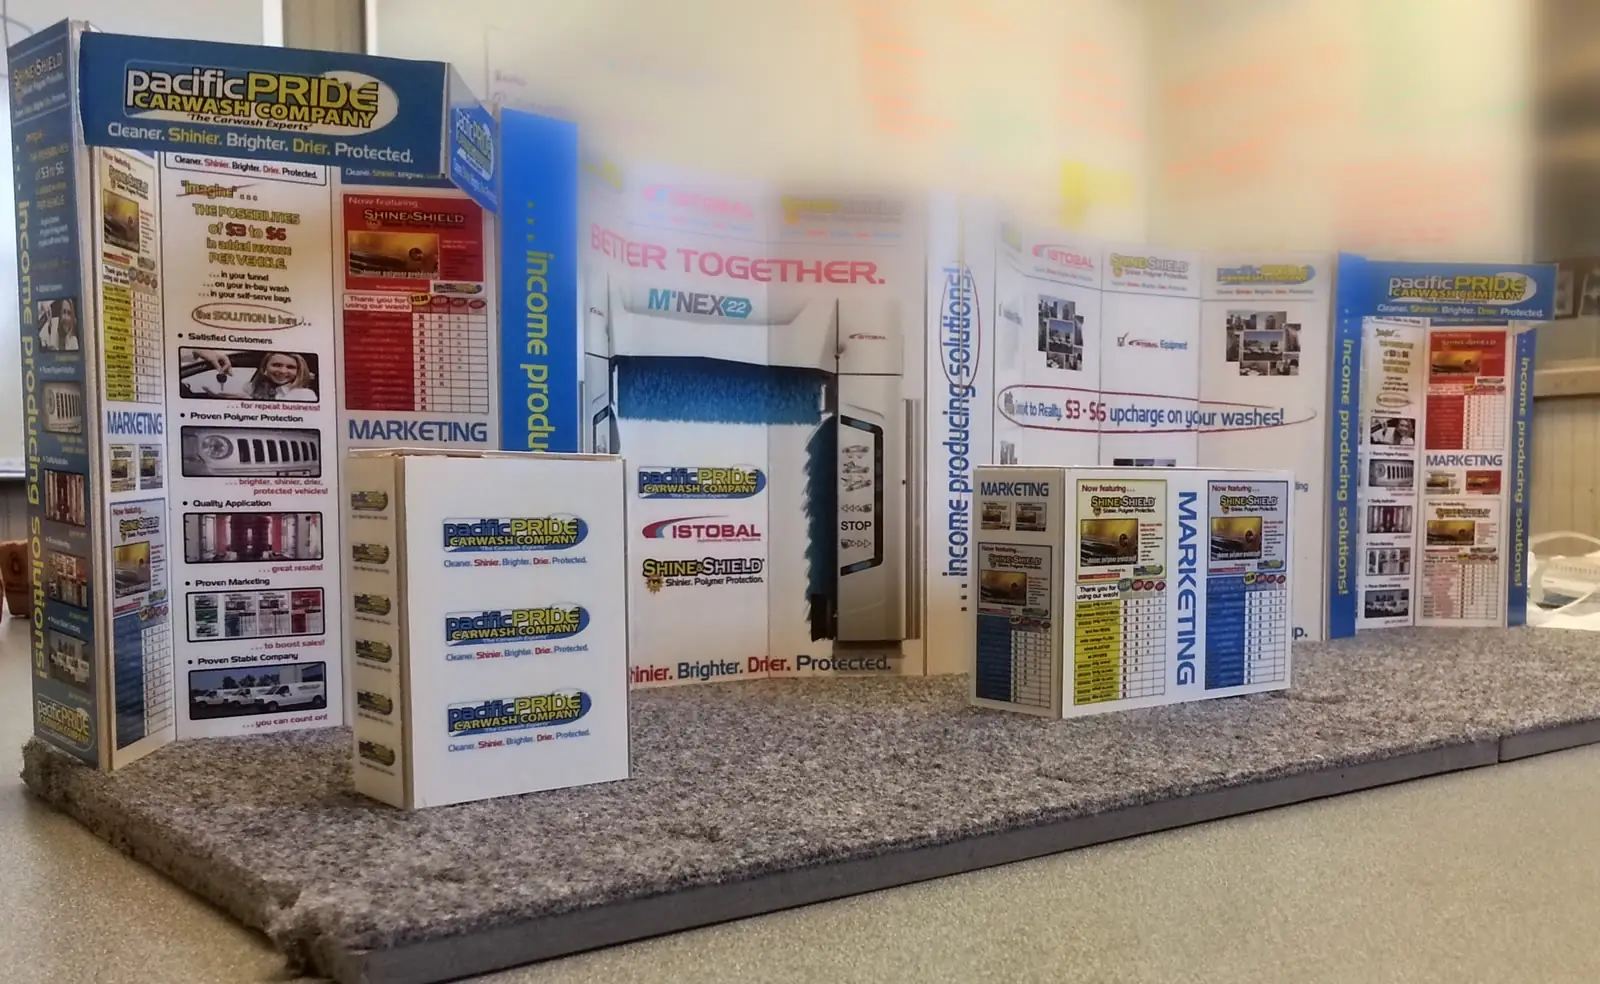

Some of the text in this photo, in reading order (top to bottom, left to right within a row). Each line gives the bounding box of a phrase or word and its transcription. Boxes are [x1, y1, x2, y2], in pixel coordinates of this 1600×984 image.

[134, 90, 379, 128] CARWASH COMPANY
[213, 115, 264, 127] Carwash
[107, 121, 414, 164] Cleaner. Shinier. Brighter. Drier. Protected.
[174, 155, 318, 179] Cleaner. Shinier. Brighter. Drier. Protected.
[192, 203, 217, 216] THE
[208, 221, 287, 242] of $3 to $6
[218, 239, 251, 252] added
[208, 251, 236, 266] PER
[590, 223, 886, 285] BETTER TOGETHER.
[229, 272, 245, 282] your
[247, 272, 269, 281] tunnel
[226, 281, 242, 290] your
[269, 284, 290, 293] wash
[218, 292, 235, 301] your
[350, 295, 375, 304] Thank
[377, 296, 394, 305] you
[345, 302, 368, 310] using
[726, 299, 748, 315] 22
[213, 310, 267, 325] SOLUTION
[188, 332, 273, 345] Satisfied Customers
[520, 249, 556, 453] income produ
[254, 402, 280, 412] repeat
[1065, 399, 1081, 420] $3
[1089, 400, 1107, 423] $6
[1110, 405, 1165, 427] upcharge
[1167, 409, 1183, 424] on
[1185, 410, 1217, 428] your
[1220, 407, 1285, 427] washes!
[22, 335, 41, 505] producing
[107, 411, 163, 435] MARKETING
[190, 412, 304, 422] Proven Polymer Protection
[348, 419, 488, 443] MARKETING
[942, 384, 977, 493] producing
[1337, 410, 1352, 502] producing
[1426, 454, 1503, 467] MARKETING
[253, 487, 293, 495] protected
[644, 483, 757, 494] CARWASH COMPANY
[980, 481, 1049, 497] MARKETING
[1081, 484, 1098, 492] Now
[1211, 484, 1227, 492] Now
[192, 499, 272, 509] Quality Application
[672, 523, 761, 539] ISTOBAL
[840, 520, 872, 531] STOP
[449, 535, 577, 547] CARWASH COMPANY
[942, 499, 969, 577] income
[473, 558, 501, 567] Shinier.
[552, 555, 589, 565] Protected.
[271, 564, 293, 574] great
[195, 576, 270, 587] Proven Marketing
[665, 575, 764, 588] Shinier. Polymer Protection.
[1176, 491, 1198, 687] MARKETING
[31, 515, 48, 680] solutions!
[451, 623, 579, 641] CARWASH COMPANY
[275, 640, 301, 649] boost
[197, 652, 299, 666] Proven Stable Company
[476, 650, 503, 660] Shinier.
[629, 654, 892, 684] hinier. Brighter. Drier. Protected.
[255, 719, 272, 729] you
[273, 717, 289, 725] can
[290, 715, 314, 723] count
[453, 708, 581, 731] CARWASH COMPANY
[478, 739, 506, 749] Shinier.
